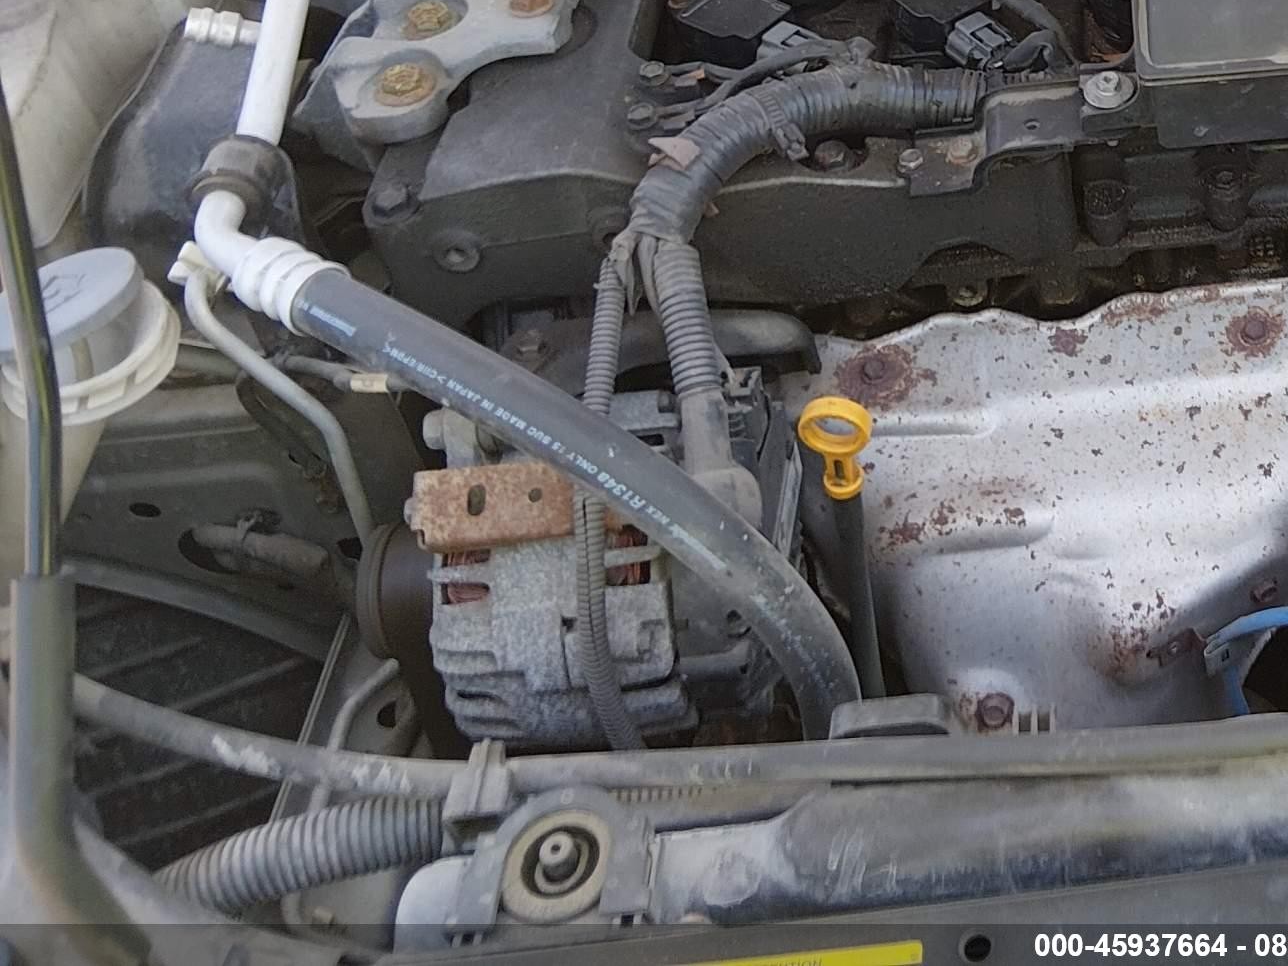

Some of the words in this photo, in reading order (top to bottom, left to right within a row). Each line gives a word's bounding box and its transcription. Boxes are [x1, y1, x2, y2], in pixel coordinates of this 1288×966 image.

[445, 377, 481, 404] JAPAN
[479, 397, 494, 412] IN
[493, 404, 527, 432] MADE
[565, 449, 599, 476] ONLY
